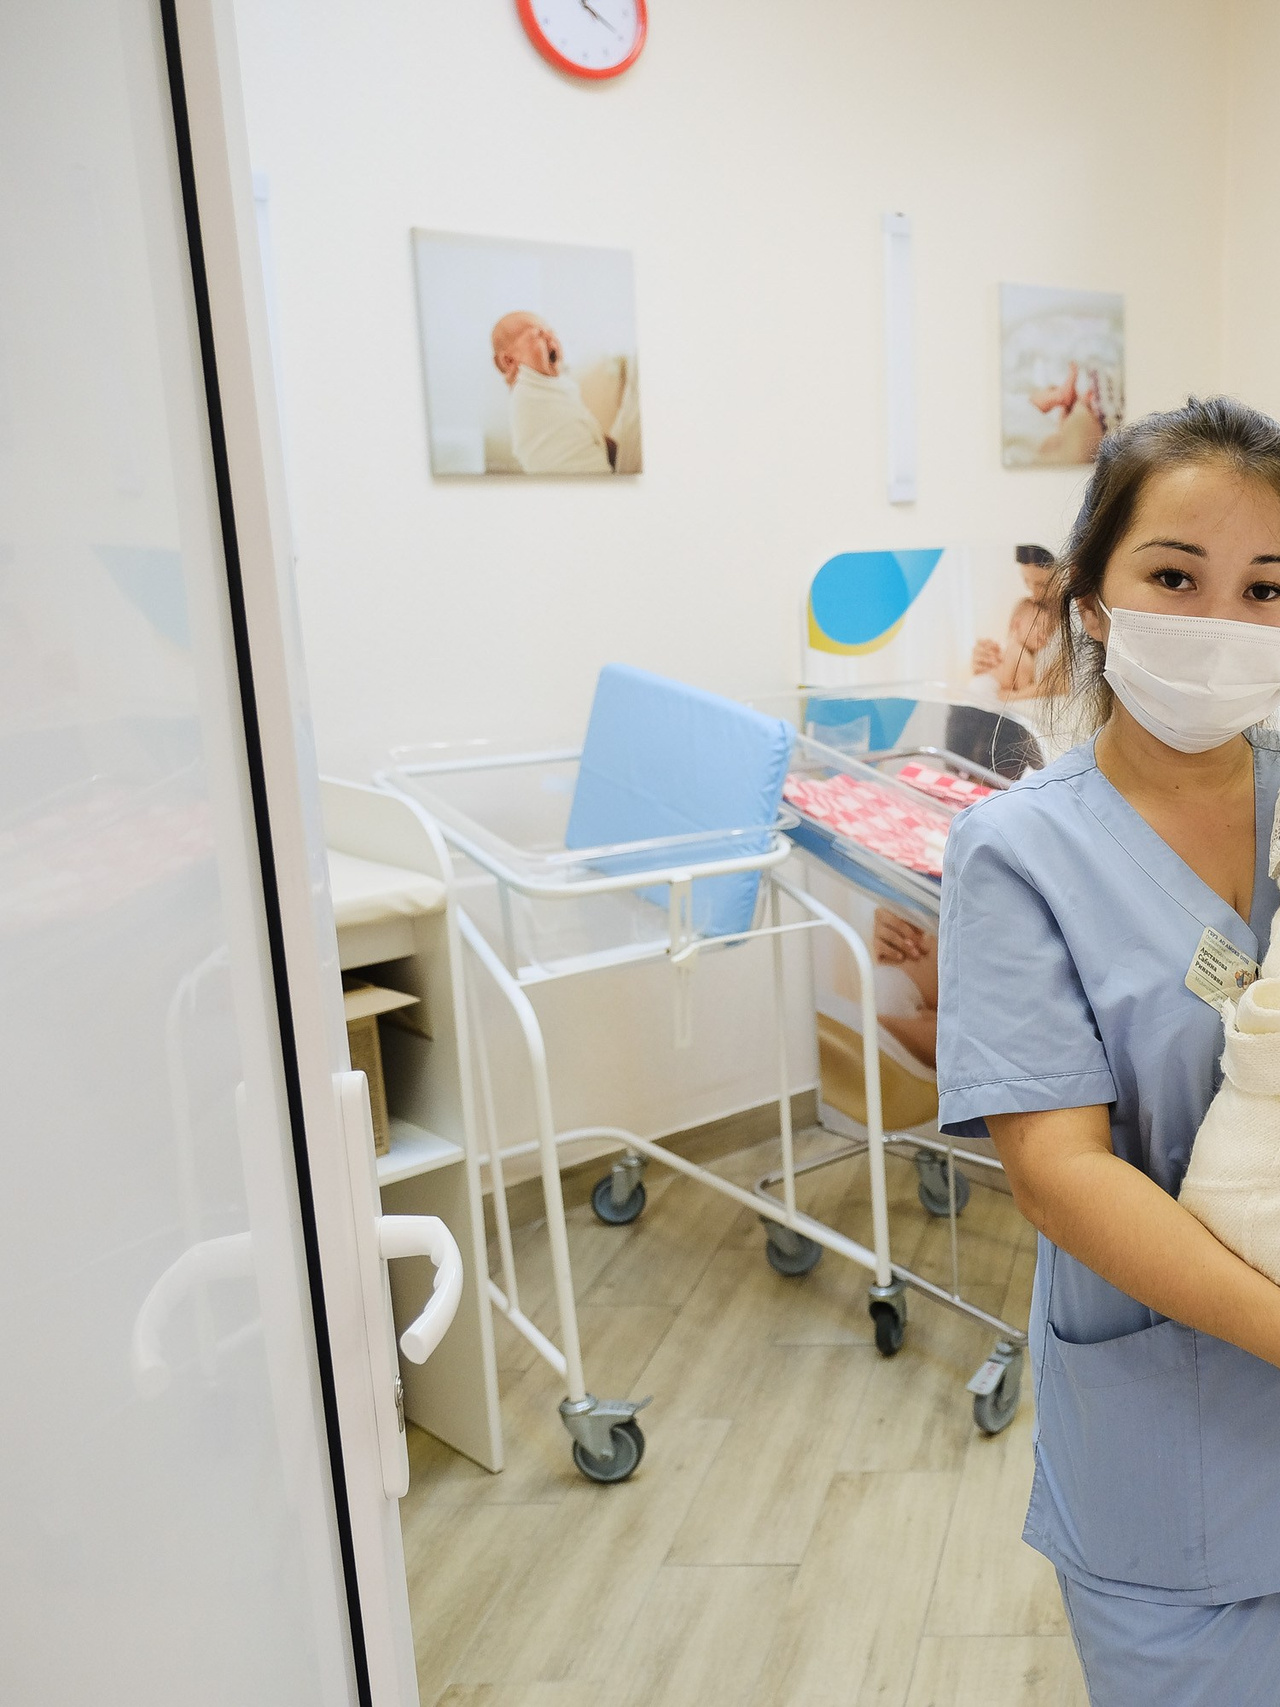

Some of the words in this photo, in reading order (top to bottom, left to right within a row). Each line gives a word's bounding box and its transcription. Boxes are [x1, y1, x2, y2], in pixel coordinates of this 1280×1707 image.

[1198, 953, 1217, 972] Сабина
[1200, 947, 1228, 971] Арстанова
[1195, 960, 1223, 986] Ринатовна
